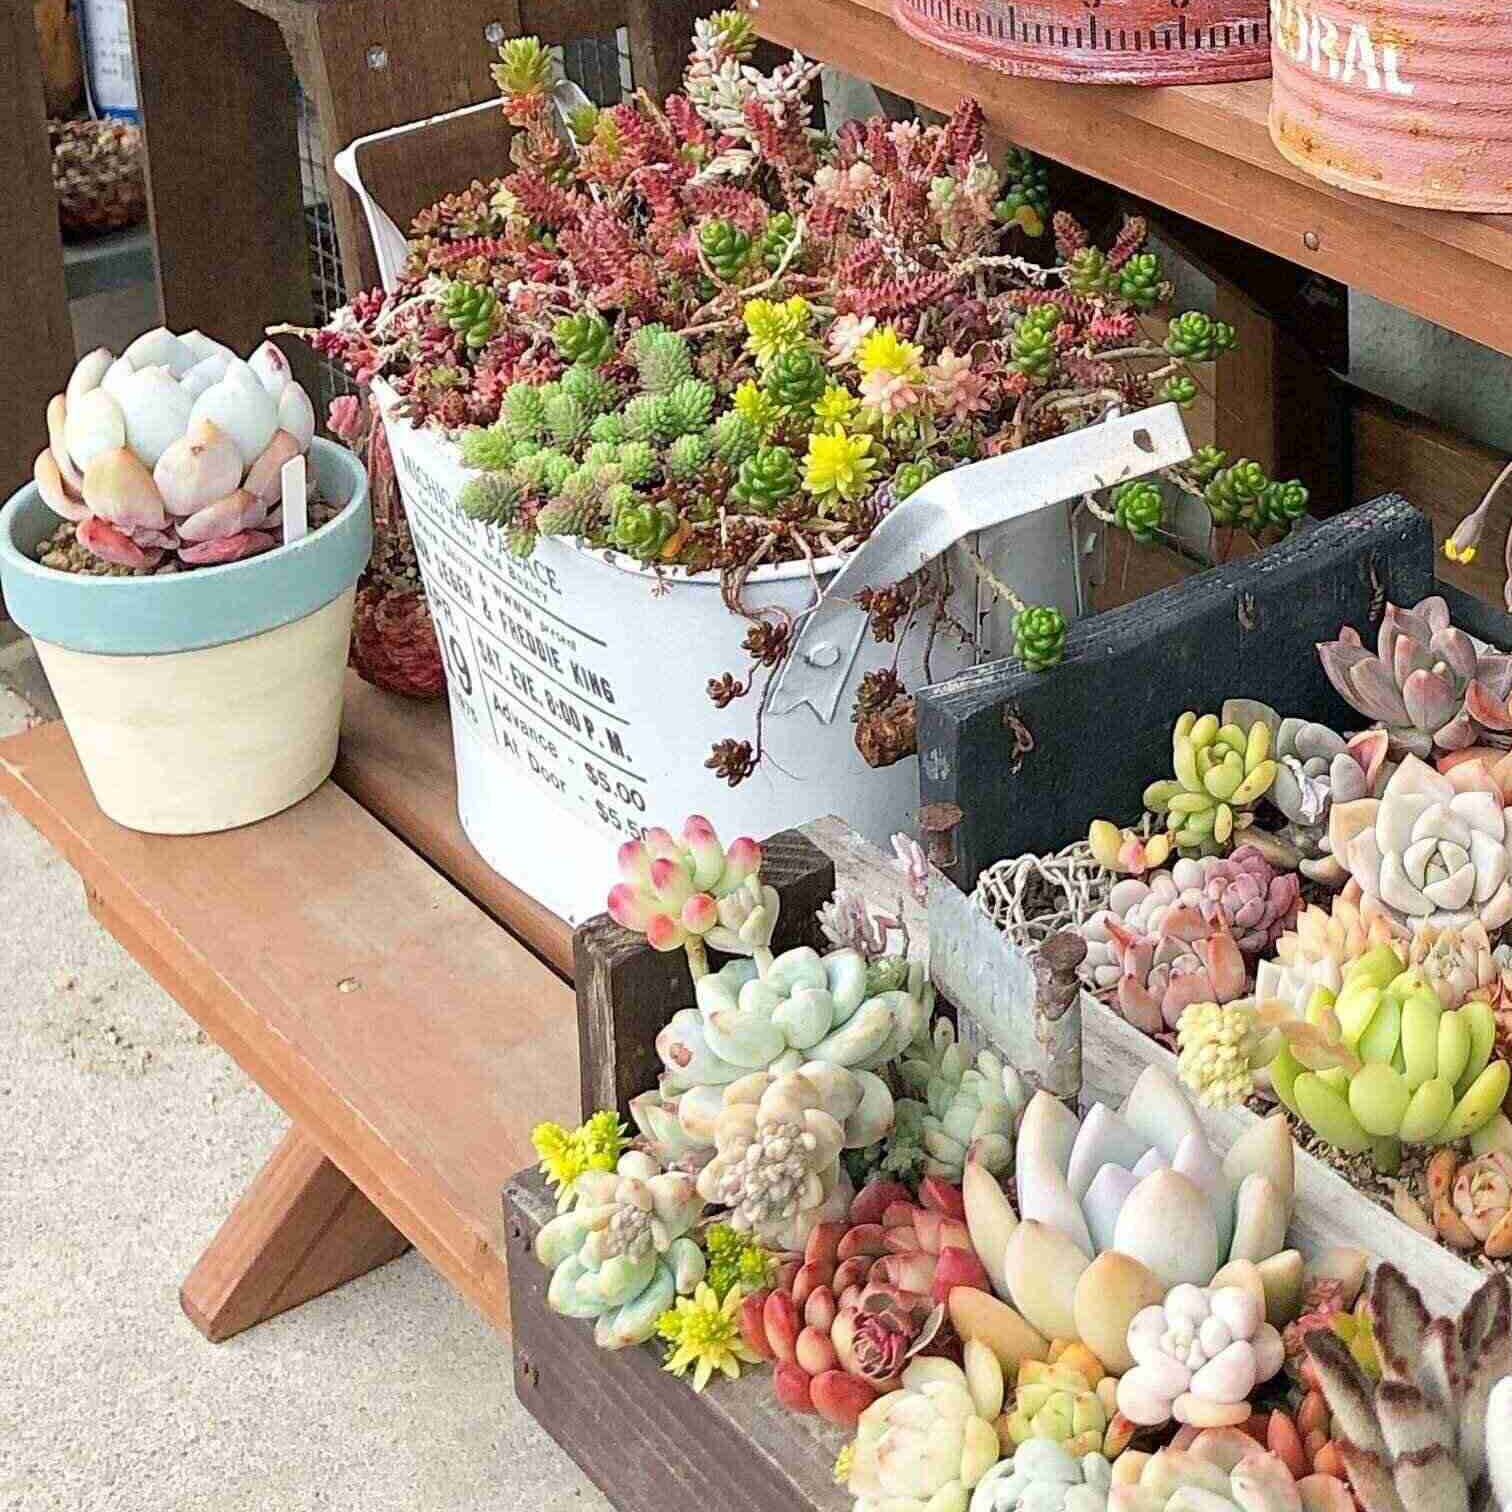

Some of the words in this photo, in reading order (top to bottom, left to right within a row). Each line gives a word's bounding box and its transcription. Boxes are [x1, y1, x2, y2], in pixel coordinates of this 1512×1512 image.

[498, 609, 563, 674] FREDDIE
[569, 659, 615, 704] KING
[493, 693, 558, 759] Advance
[584, 761, 645, 812] $5.00
[503, 731, 520, 759] At
[527, 751, 566, 793] Door
